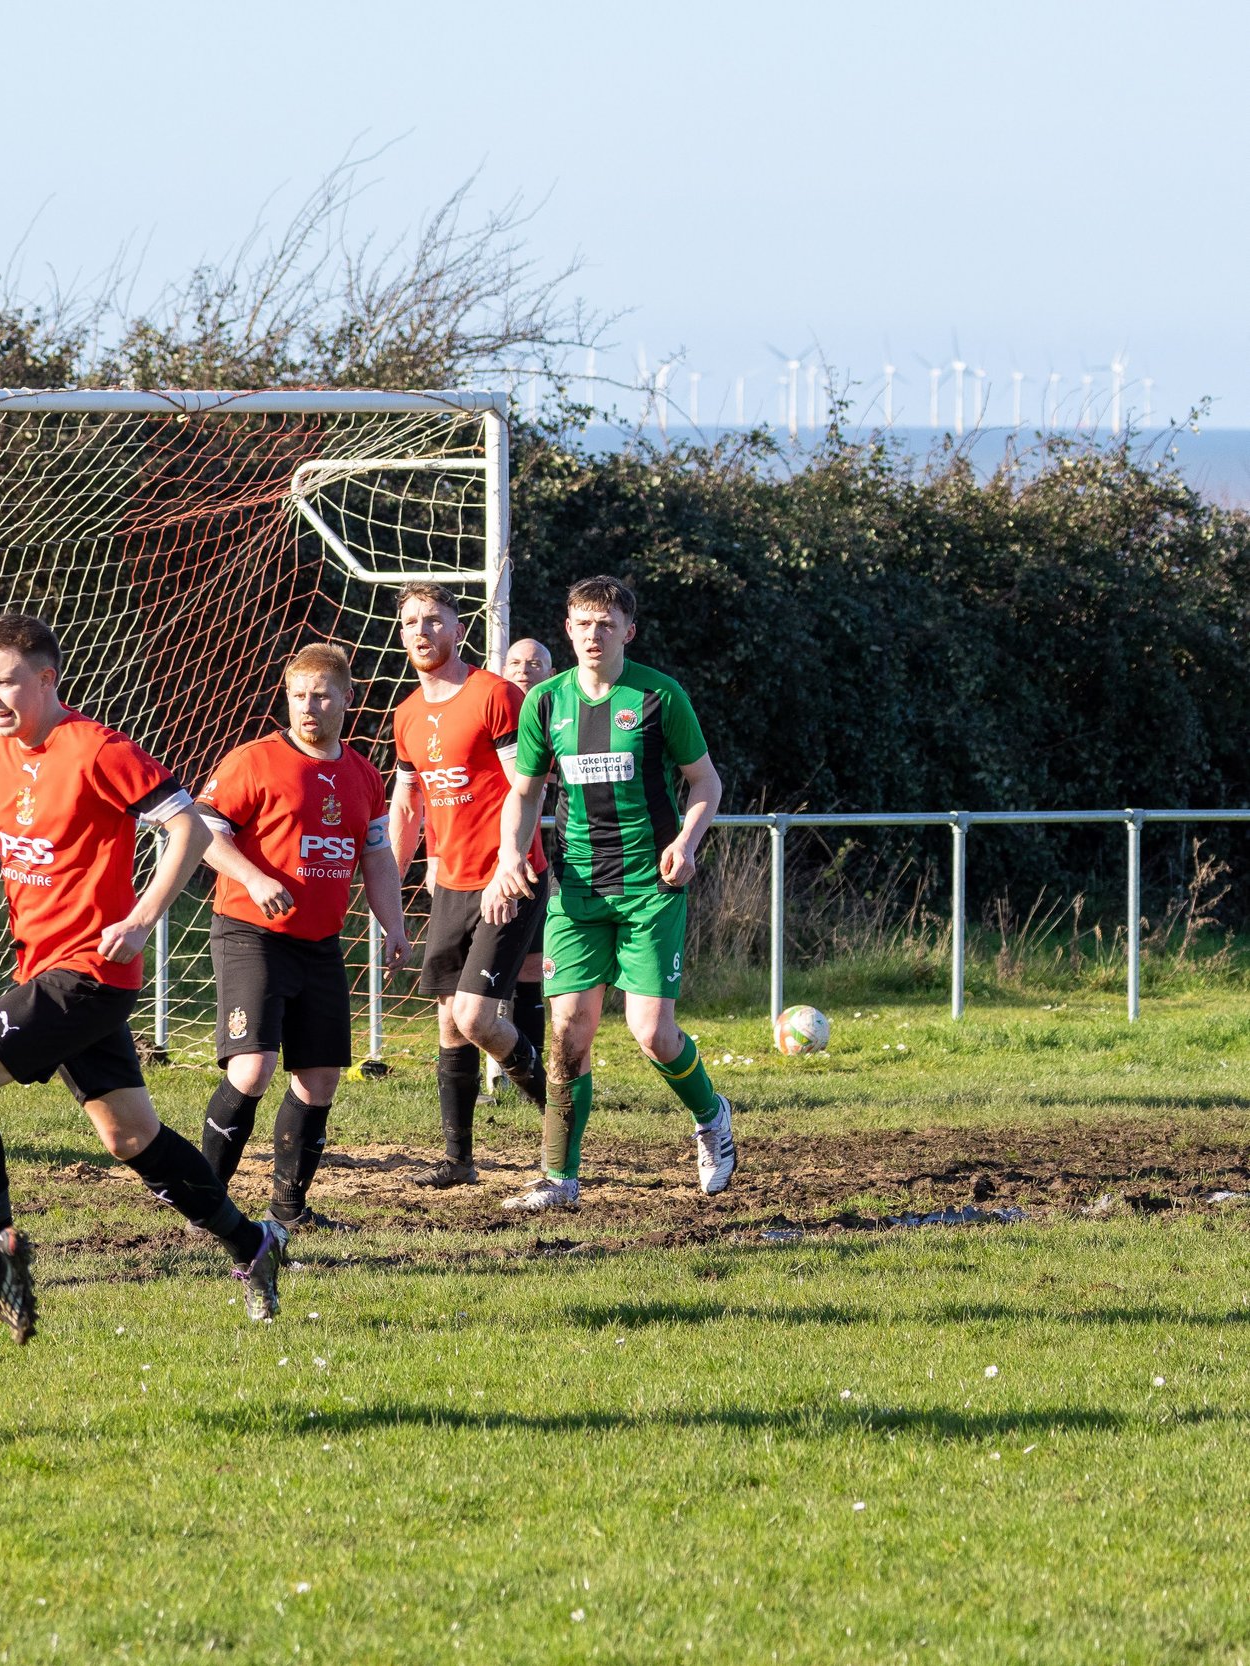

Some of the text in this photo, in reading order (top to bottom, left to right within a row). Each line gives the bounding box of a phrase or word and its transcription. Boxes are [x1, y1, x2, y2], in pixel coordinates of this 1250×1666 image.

[577, 755, 622, 766] Lakeland
[579, 763, 632, 774] Verandahs
[419, 766, 470, 791] PSS
[300, 835, 356, 860] PSS
[296, 866, 325, 878] AUTO
[673, 951, 680, 971] 6
